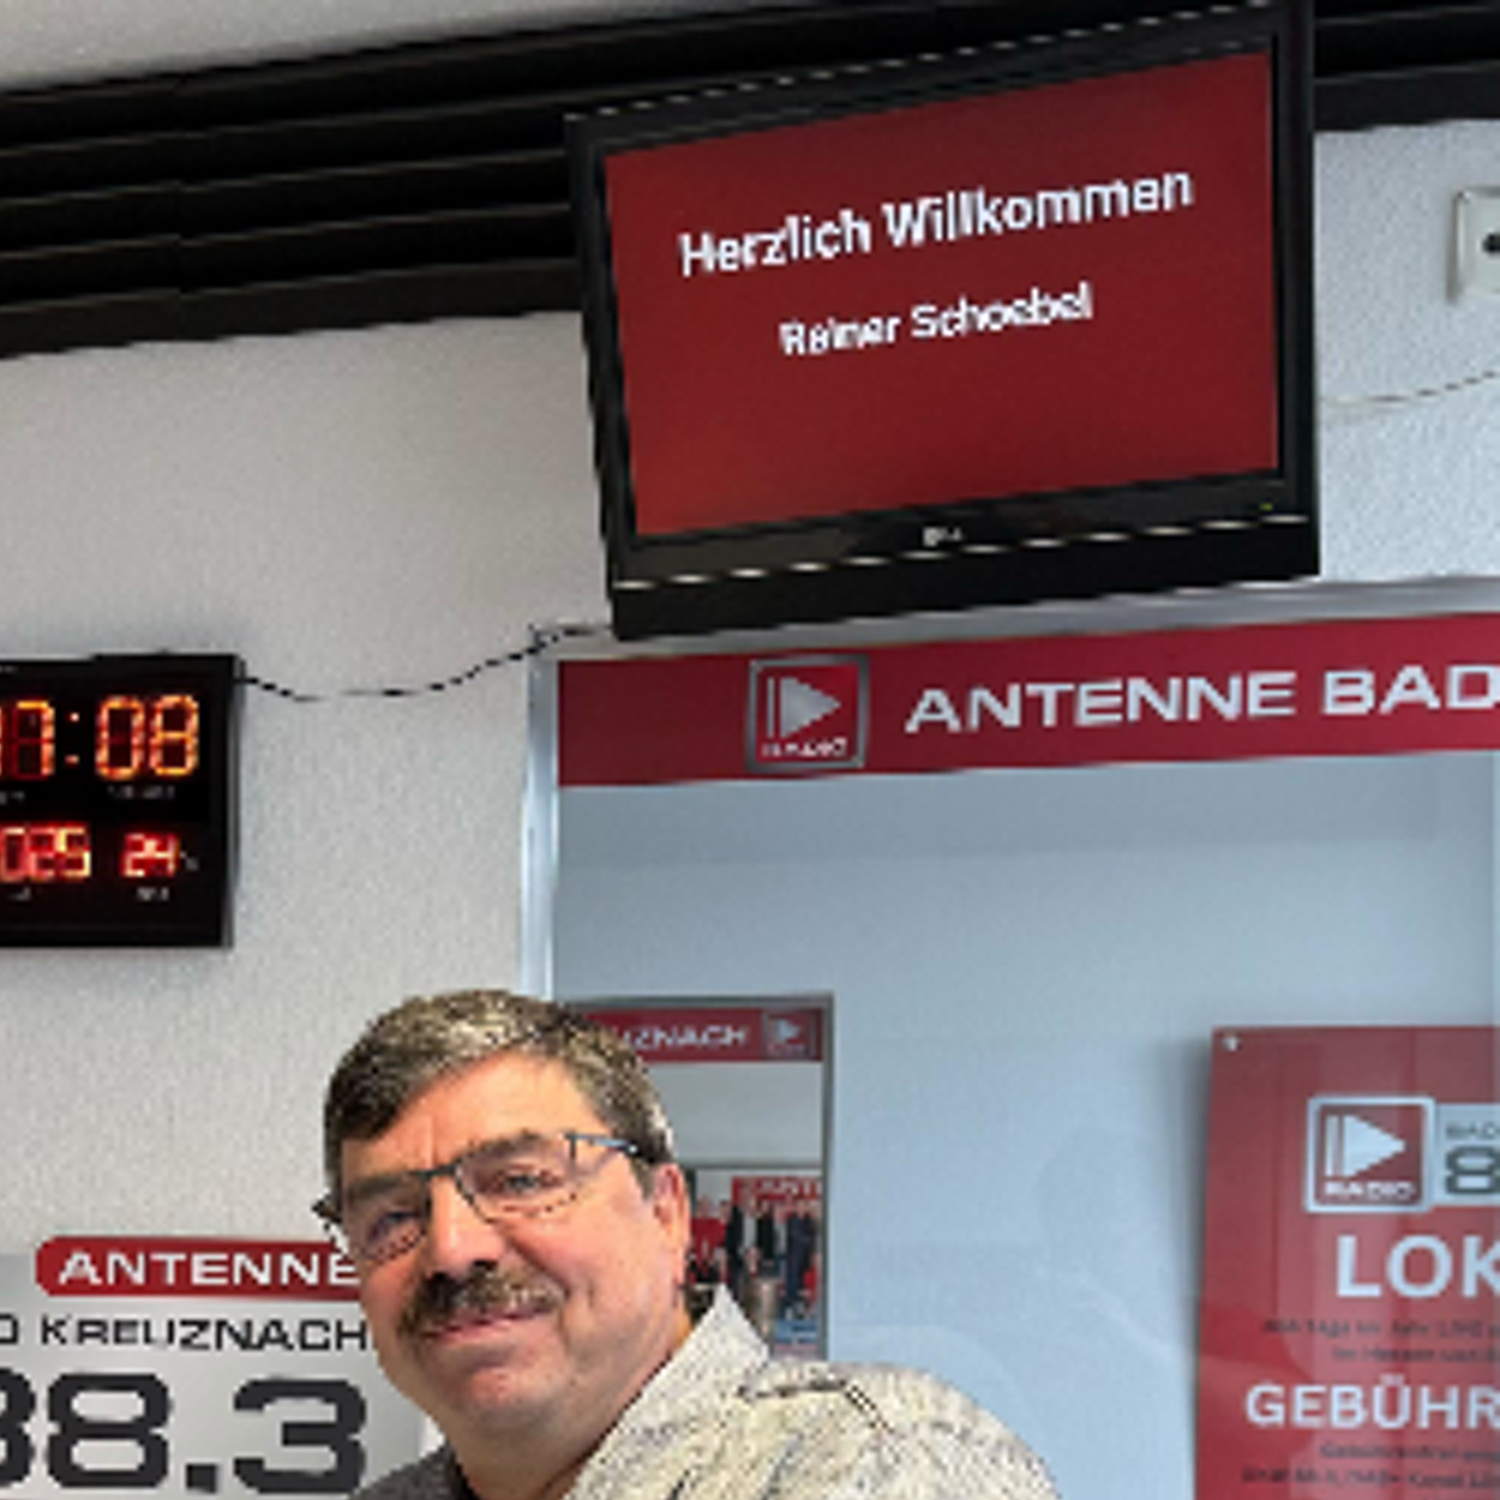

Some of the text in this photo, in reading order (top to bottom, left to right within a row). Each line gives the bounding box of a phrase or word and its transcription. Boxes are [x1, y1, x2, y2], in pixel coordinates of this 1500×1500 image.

[678, 172, 1192, 277] Herzlich Willkommen
[779, 316, 900, 356] Reiner
[905, 665, 1500, 733] ANTENNE BAD
[623, 1026, 746, 1049] ZNACH
[58, 1253, 360, 1286] ANTENNE
[1336, 1234, 1500, 1298] LOK
[41, 1317, 367, 1351] KREUZNACH
[1245, 1374, 1500, 1430] GEBÜHR
